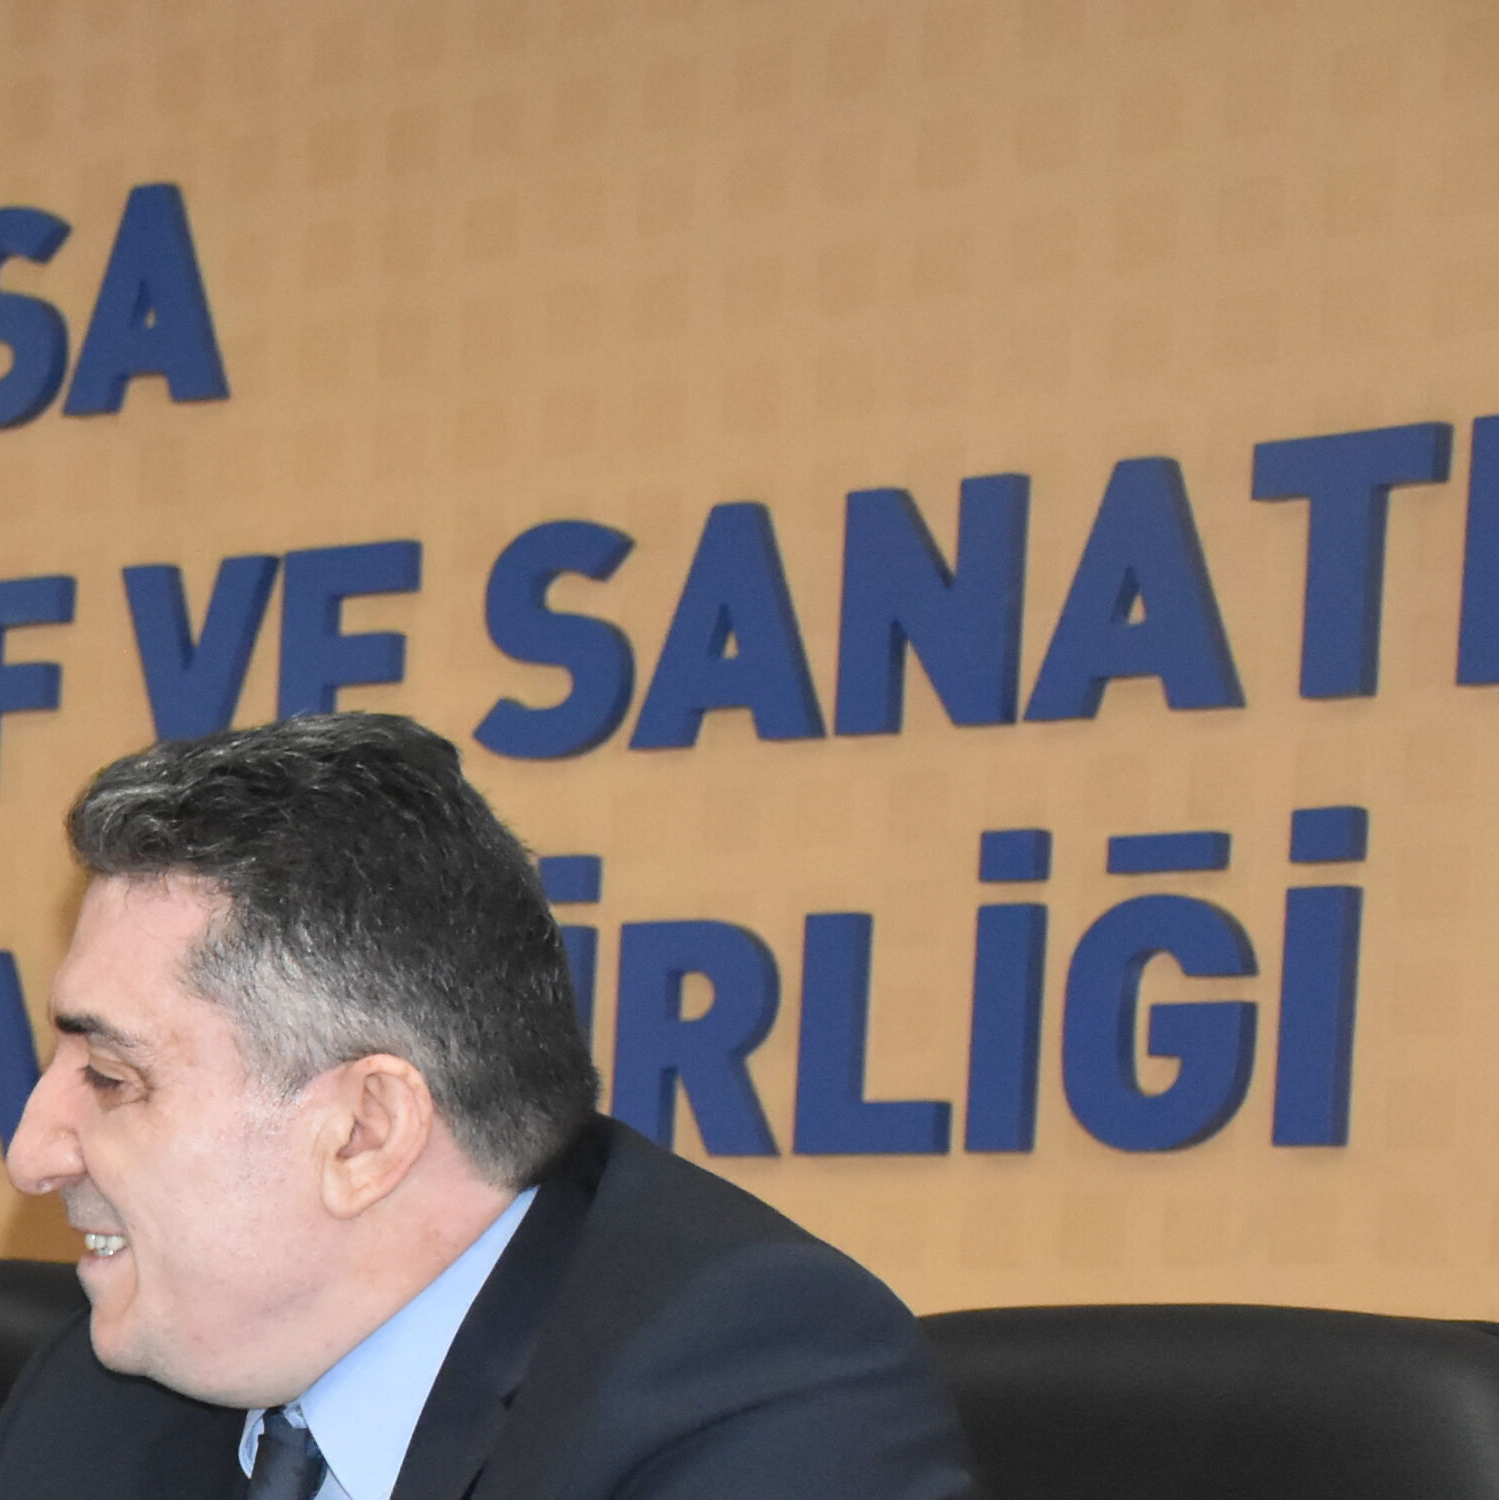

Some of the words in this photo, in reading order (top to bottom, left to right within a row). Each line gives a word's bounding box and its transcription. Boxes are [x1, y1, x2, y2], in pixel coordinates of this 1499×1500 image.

[121, 538, 423, 746] VE
[471, 414, 1499, 761] SANAT
[536, 805, 1370, 1158] RLİĞİ
